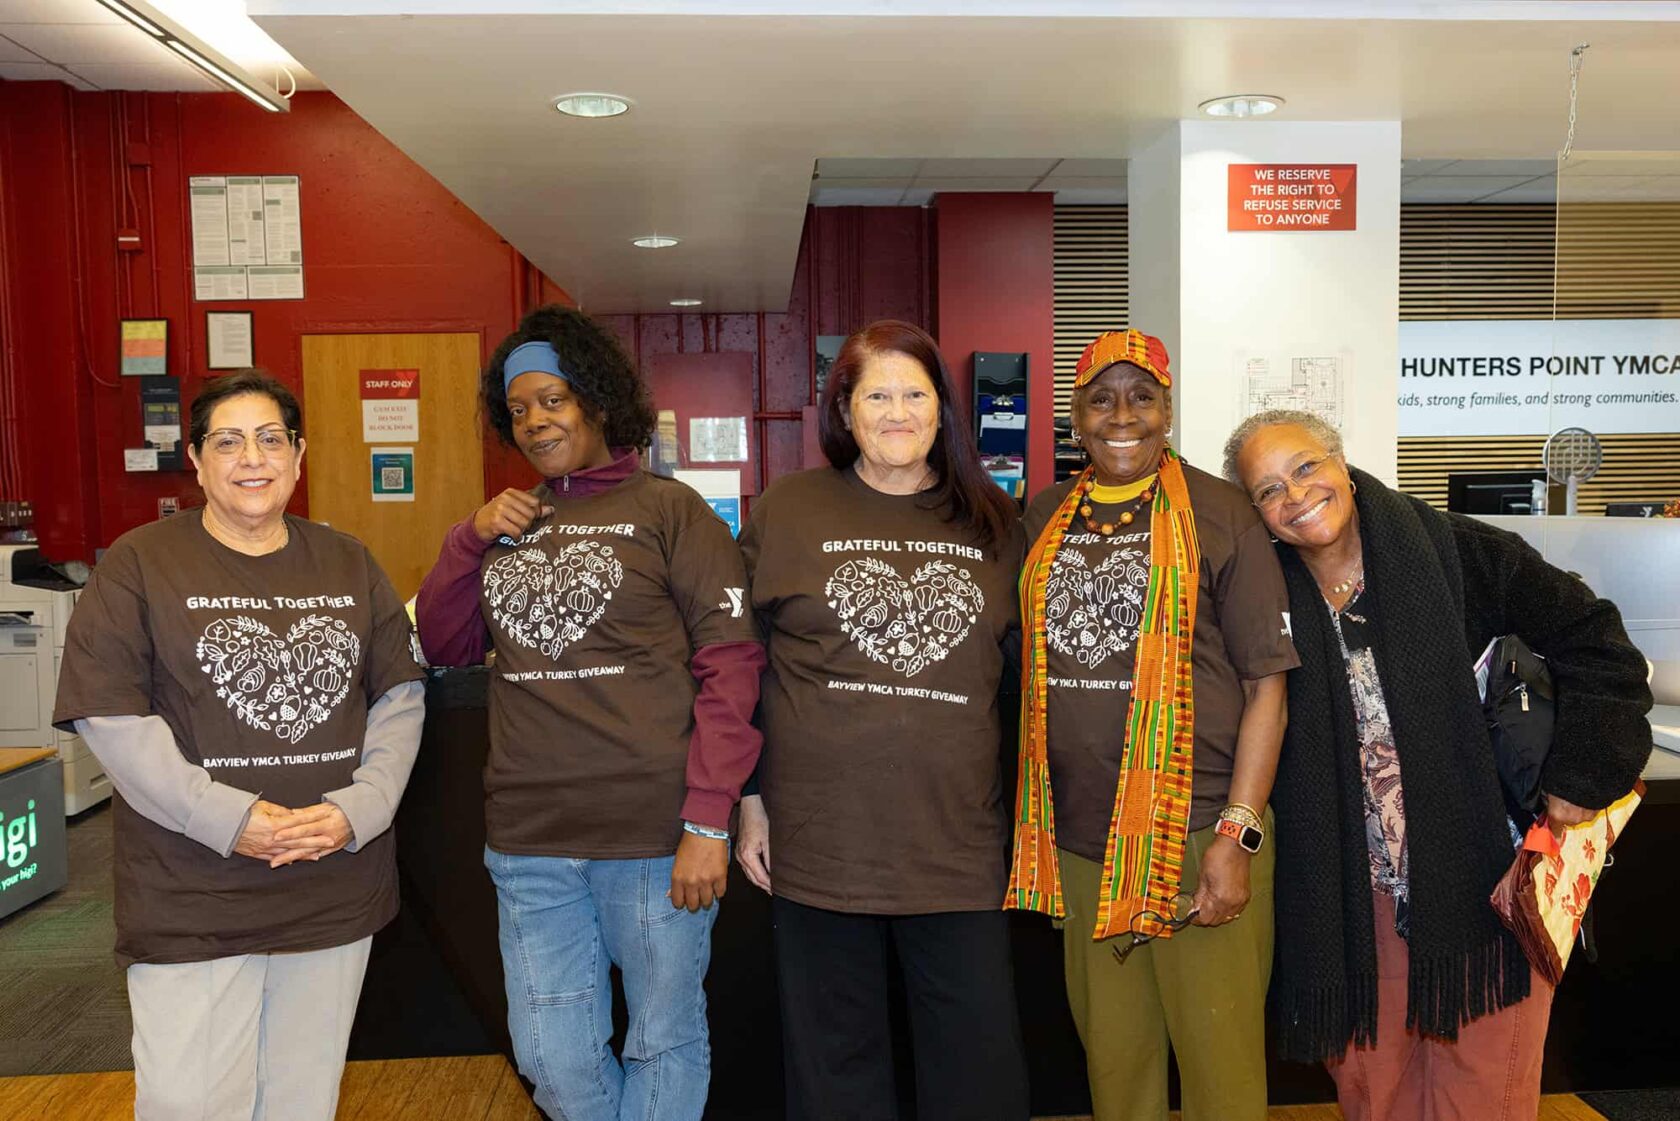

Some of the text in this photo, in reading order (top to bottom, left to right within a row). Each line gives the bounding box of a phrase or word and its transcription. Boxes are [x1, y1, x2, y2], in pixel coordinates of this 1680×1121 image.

[1255, 169, 1330, 180] WE RESERVE
[1250, 184, 1335, 195] THE RIGHT TO
[1243, 199, 1341, 210] REFUSE SERVICE
[1255, 213, 1330, 224] TO ANYONE
[1401, 355, 1680, 377] HUNTERS POINT YMCA
[365, 380, 413, 389] STAFF ONLY
[1427, 394, 1465, 409] strong
[1470, 391, 1521, 408] families,
[1525, 391, 1549, 405] and
[1553, 393, 1592, 408] strong
[1595, 390, 1679, 404] communities.
[558, 523, 635, 537] TOGETHER
[1062, 532, 1151, 545] TEFUL TOGET
[822, 539, 983, 561] GRATEFUL TOGETHER
[186, 594, 356, 610] GRATEFUL TOGETHER
[519, 671, 543, 681] YMCA
[545, 670, 577, 680] TURKEY
[578, 665, 625, 679] GIVEAWAY
[827, 680, 969, 705] BAYVIEW YMCA TURKEY GIVEAWAY
[1080, 679, 1117, 690] TURKEY
[203, 747, 357, 768] BAYVIEW YMCA TURKEY GIVEAWAY
[0, 799, 37, 868] igi
[1, 862, 38, 891] your higi?
